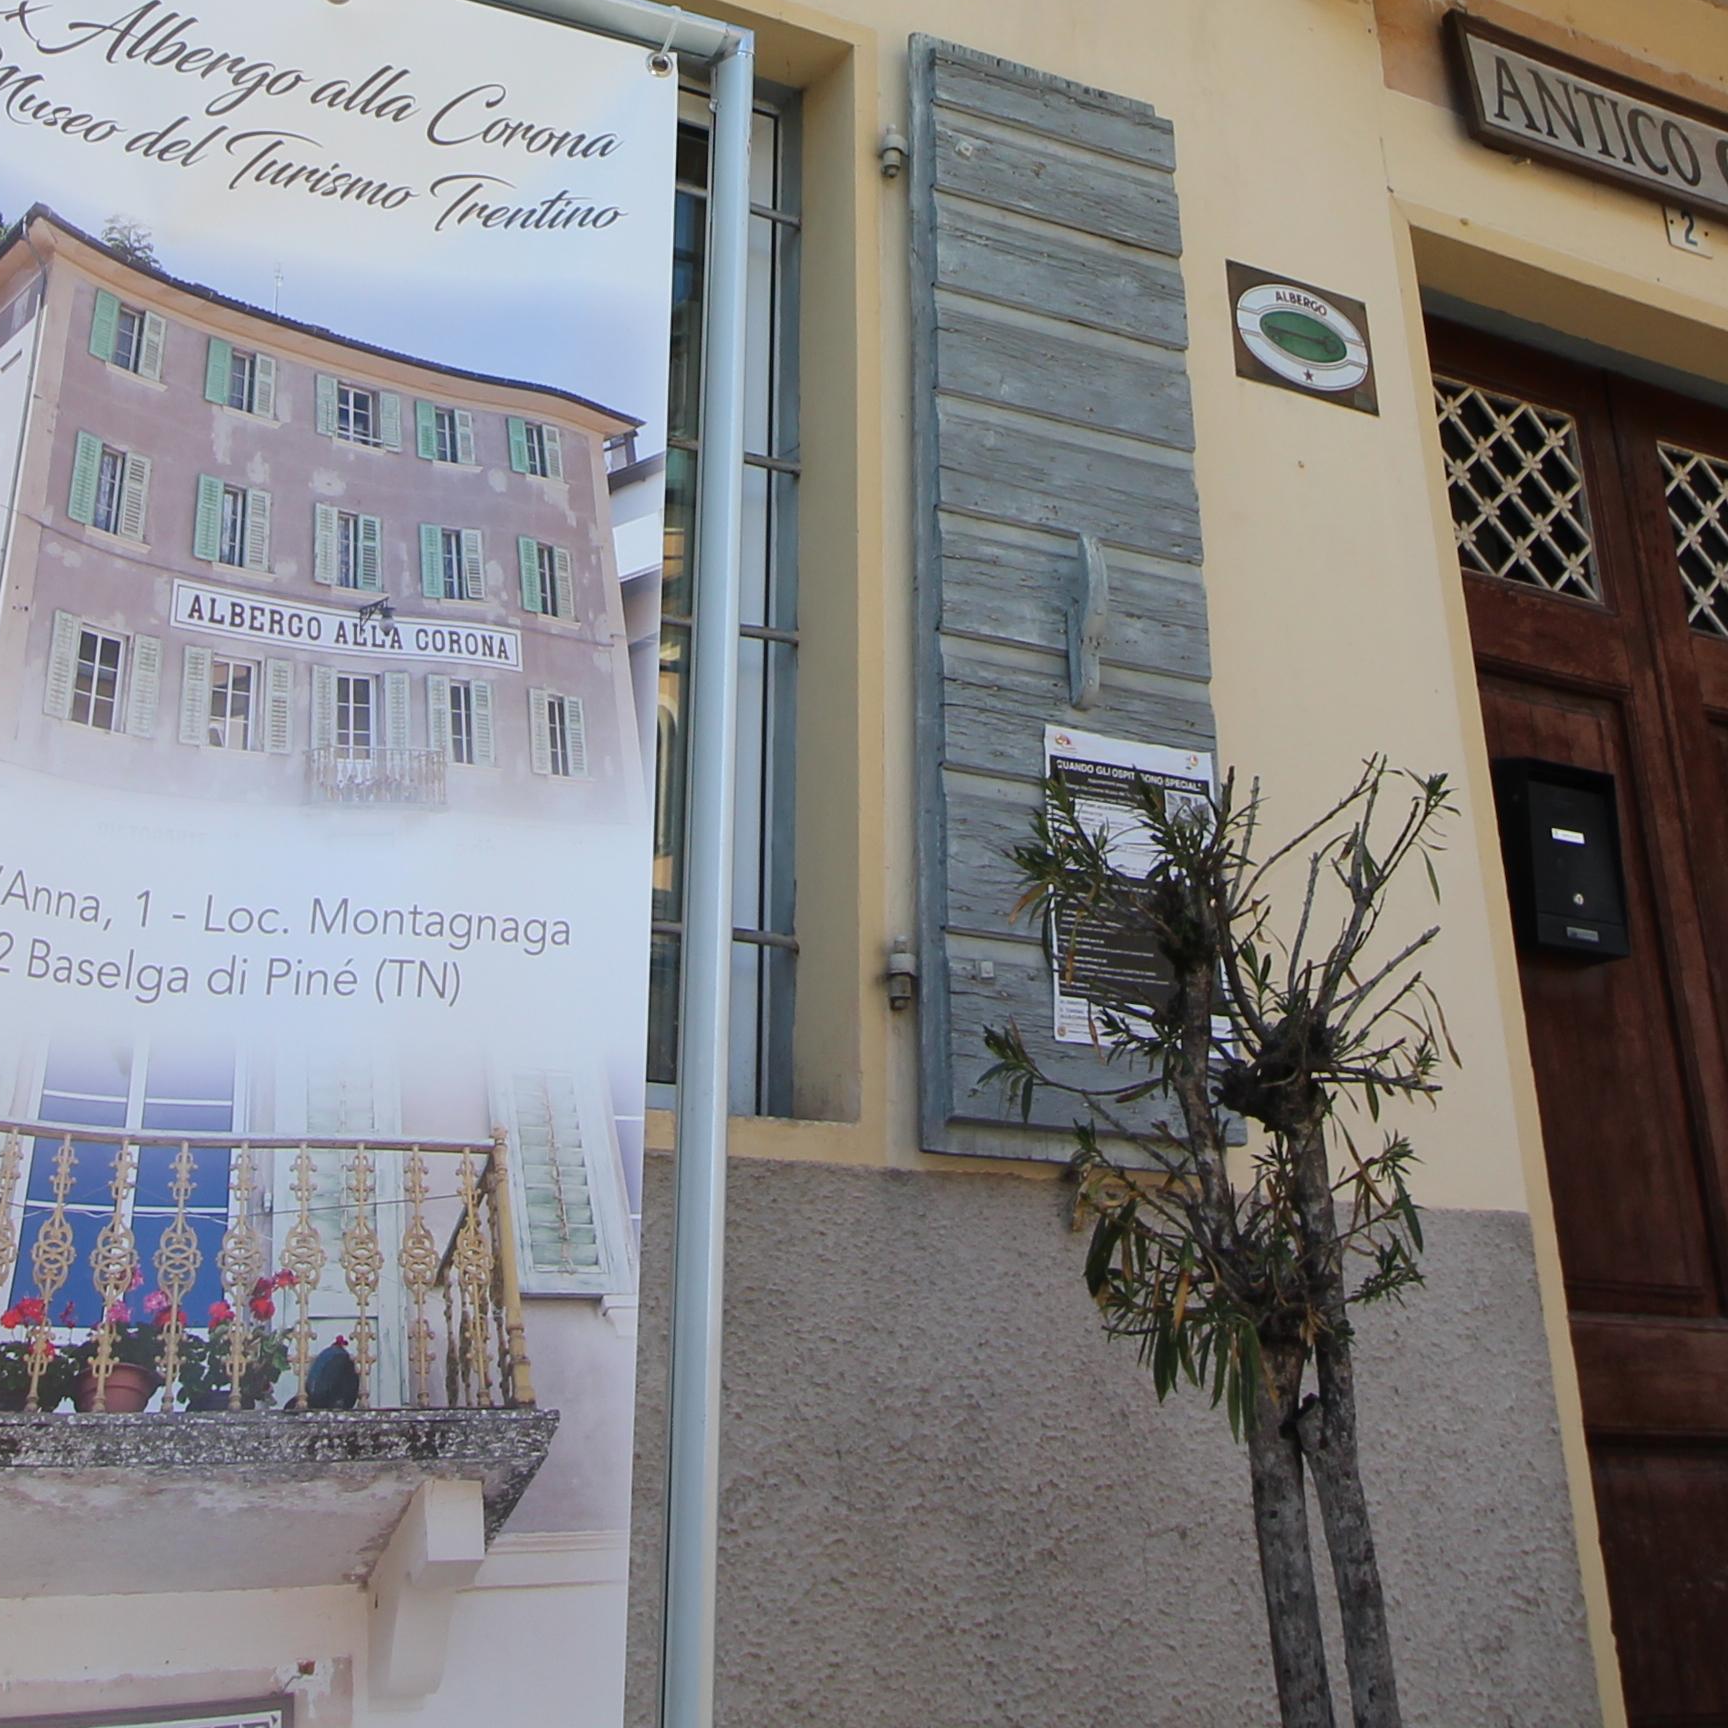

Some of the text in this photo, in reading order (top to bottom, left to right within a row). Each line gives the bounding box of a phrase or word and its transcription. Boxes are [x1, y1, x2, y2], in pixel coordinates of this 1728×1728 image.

[309, 65, 421, 124] alla
[427, 83, 624, 160] Corona
[1493, 54, 1702, 189] ANTICO
[124, 116, 212, 169] del
[225, 129, 420, 210] Turismo
[428, 173, 627, 233] Trentino
[1681, 209, 1699, 247] 2
[1274, 290, 1328, 318] ALBERGO
[187, 594, 512, 660] ALBERGO ALLA CORONA
[1164, 777, 1202, 792] SPECIAL
[135, 889, 153, 929] 1
[203, 894, 291, 937] Loc.
[308, 897, 573, 957] Montagnaga
[26, 945, 190, 1003] Baselga
[207, 954, 248, 997] di
[267, 957, 359, 997] Piné
[373, 958, 463, 1006] (TN)
